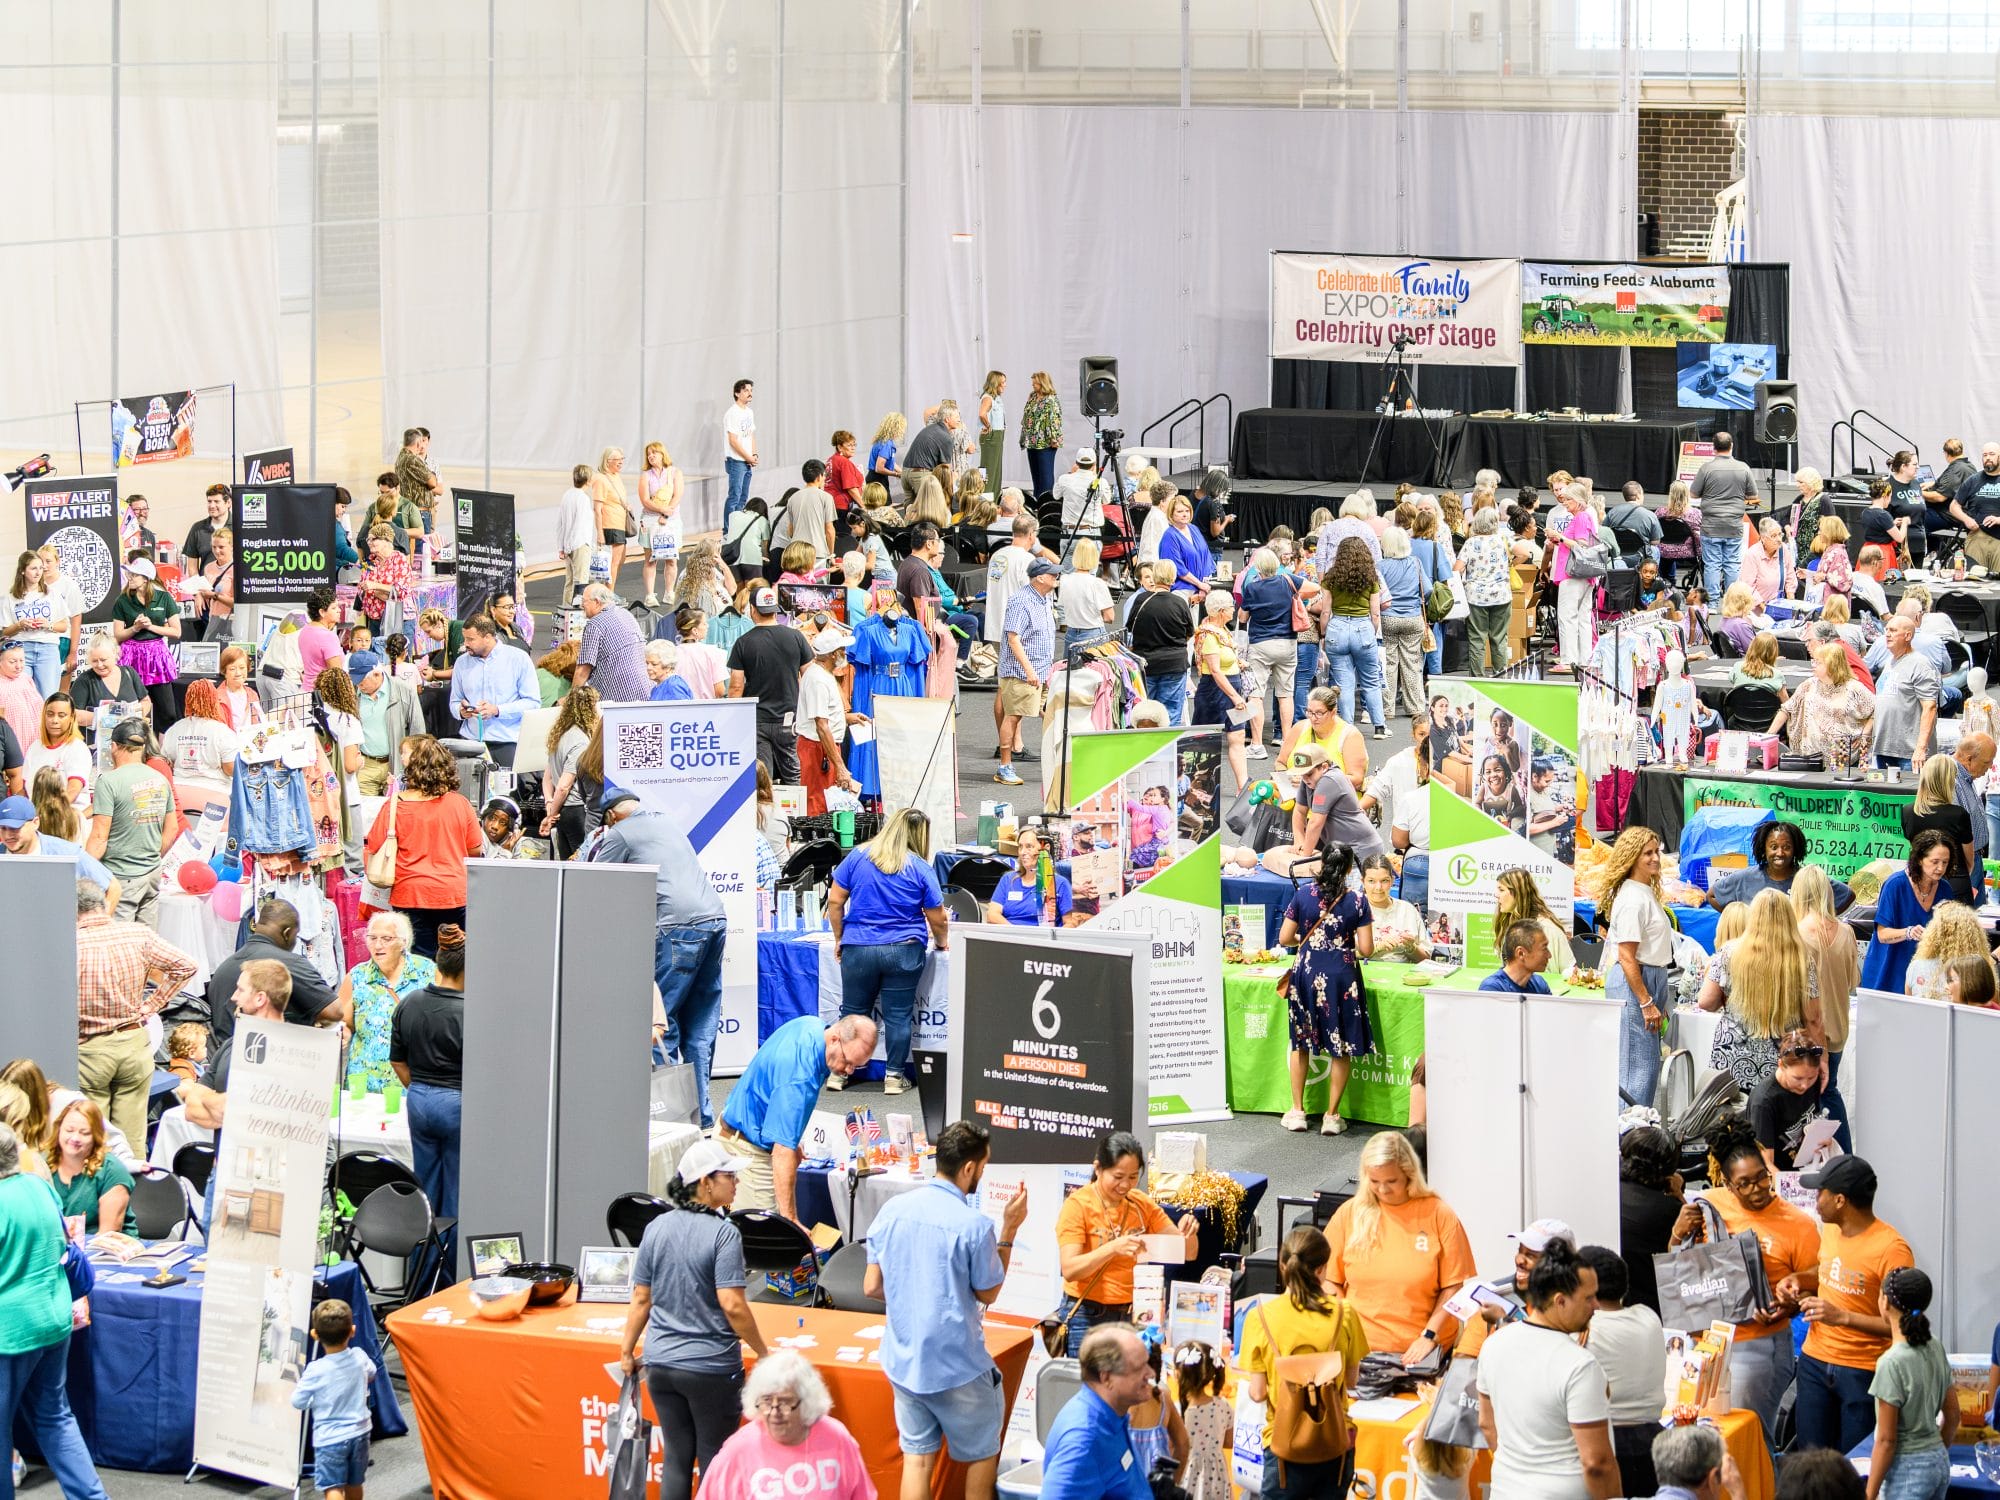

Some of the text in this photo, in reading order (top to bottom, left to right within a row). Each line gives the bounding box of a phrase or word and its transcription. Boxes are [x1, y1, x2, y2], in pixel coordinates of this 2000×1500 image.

[1317, 262, 1470, 303] Celebrate the Family
[1540, 273, 1715, 288] Farming Feeds Alabama
[1324, 293, 1389, 318] EXPO
[1295, 319, 1383, 348] Celebrity
[1439, 324, 1496, 349] Stage
[144, 423, 171, 439] FRESH
[145, 437, 170, 452] BOBA
[261, 462, 290, 480] WBRC
[33, 490, 111, 506] FIRST ALERT
[32, 503, 112, 522] WEATHER
[242, 539, 309, 548] Register to win
[458, 542, 503, 554] The nation's best
[442, 550, 451, 558] 56
[458, 553, 513, 567] replacement window
[243, 550, 326, 575] $25,000
[458, 563, 469, 572] and
[470, 564, 483, 573] door
[249, 577, 278, 585] Windows
[252, 585, 277, 593] Renewal
[285, 585, 314, 593] Andersen
[669, 720, 715, 734] Get A
[670, 735, 721, 751] FREE
[670, 751, 741, 771] QUOTE
[1799, 818, 1823, 830] JULIE
[1824, 819, 1861, 832] PHILLIPS
[1871, 822, 1902, 835] OWNER
[710, 871, 738, 881] for a
[713, 883, 744, 893] OME
[1152, 941, 1195, 959] BHM
[1023, 959, 1072, 978] EVERY
[1031, 979, 1061, 1039] 6
[1162, 998, 1194, 1006] addressing
[1153, 1029, 1191, 1038] experiencing
[1013, 1039, 1079, 1060] MINUTES
[1009, 1058, 1017, 1066] A
[1018, 1058, 1056, 1072] PERSON
[1164, 1061, 1190, 1069] partners
[983, 1069, 1109, 1093] in the United States of drug overdose.
[250, 1083, 330, 1121] rethinking
[977, 1102, 1115, 1129] ALL ARE UNNECESSARY.
[247, 1113, 327, 1145] renovation
[991, 1115, 1096, 1138] ONE IS TOO MANY.
[814, 1128, 826, 1144] 20
[1064, 1169, 1075, 1177] The
[580, 1395, 620, 1417] the
[750, 1459, 841, 1500] GOD
